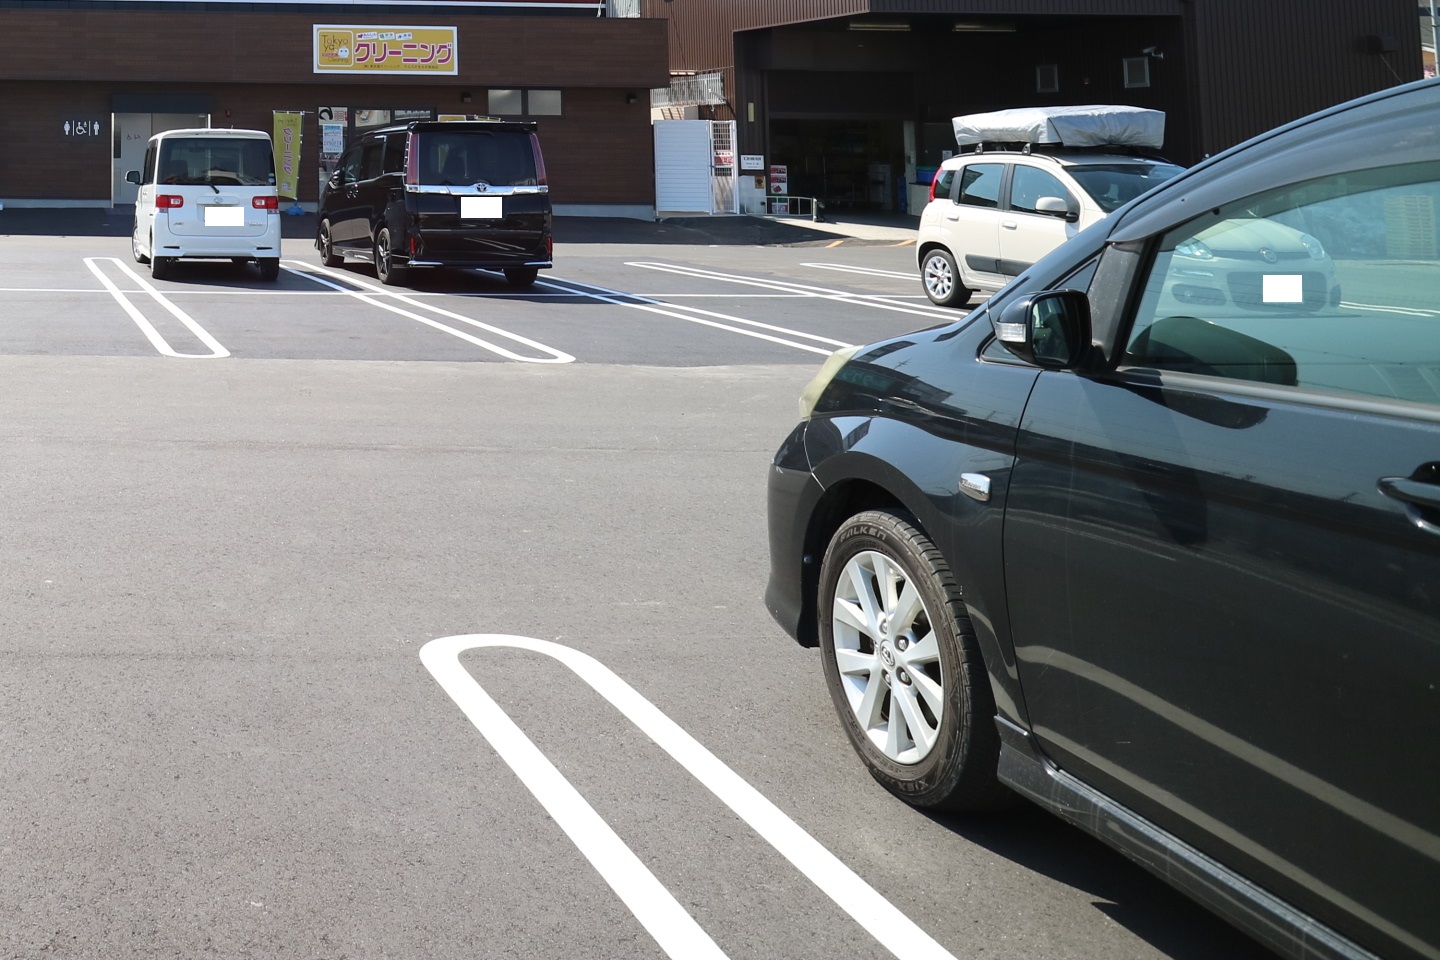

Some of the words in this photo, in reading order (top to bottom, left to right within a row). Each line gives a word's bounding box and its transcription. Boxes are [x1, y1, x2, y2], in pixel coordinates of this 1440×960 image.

[321, 34, 349, 48] Tokyo
[355, 43, 452, 64] クリーニング
[840, 526, 887, 542] FALKEN
